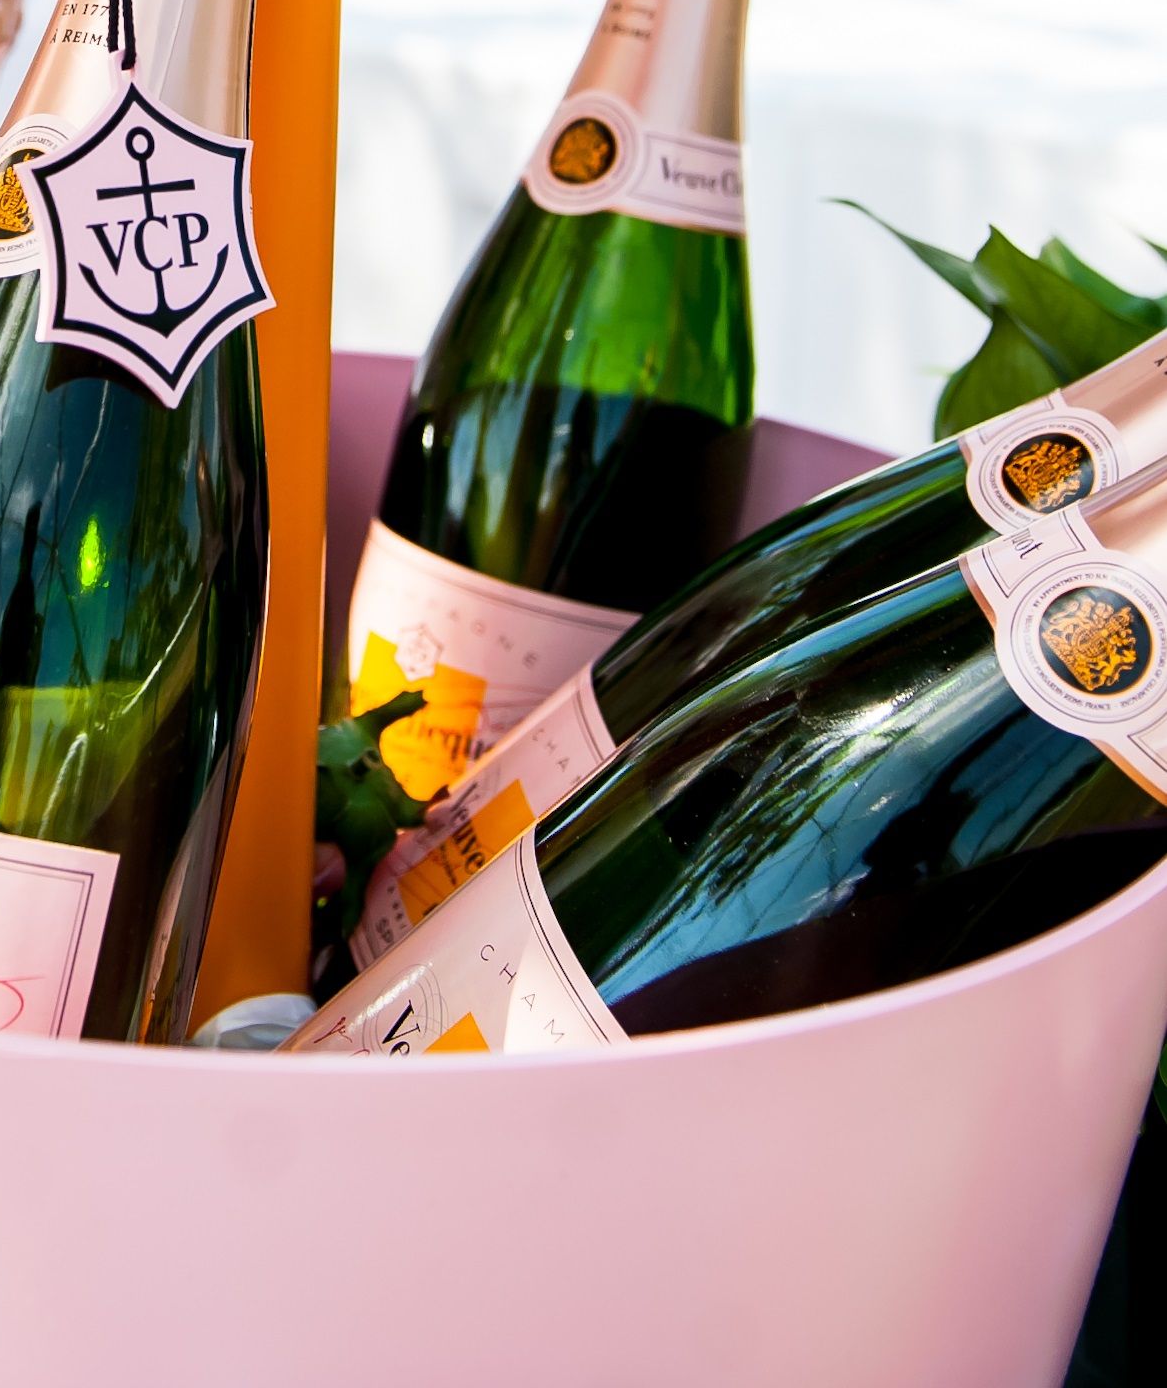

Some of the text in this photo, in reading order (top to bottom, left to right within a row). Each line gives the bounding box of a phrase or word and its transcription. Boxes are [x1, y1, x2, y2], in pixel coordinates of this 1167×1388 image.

[62, 3, 78, 16] EN
[62, 28, 111, 48] REIMS
[86, 212, 210, 276] VCP
